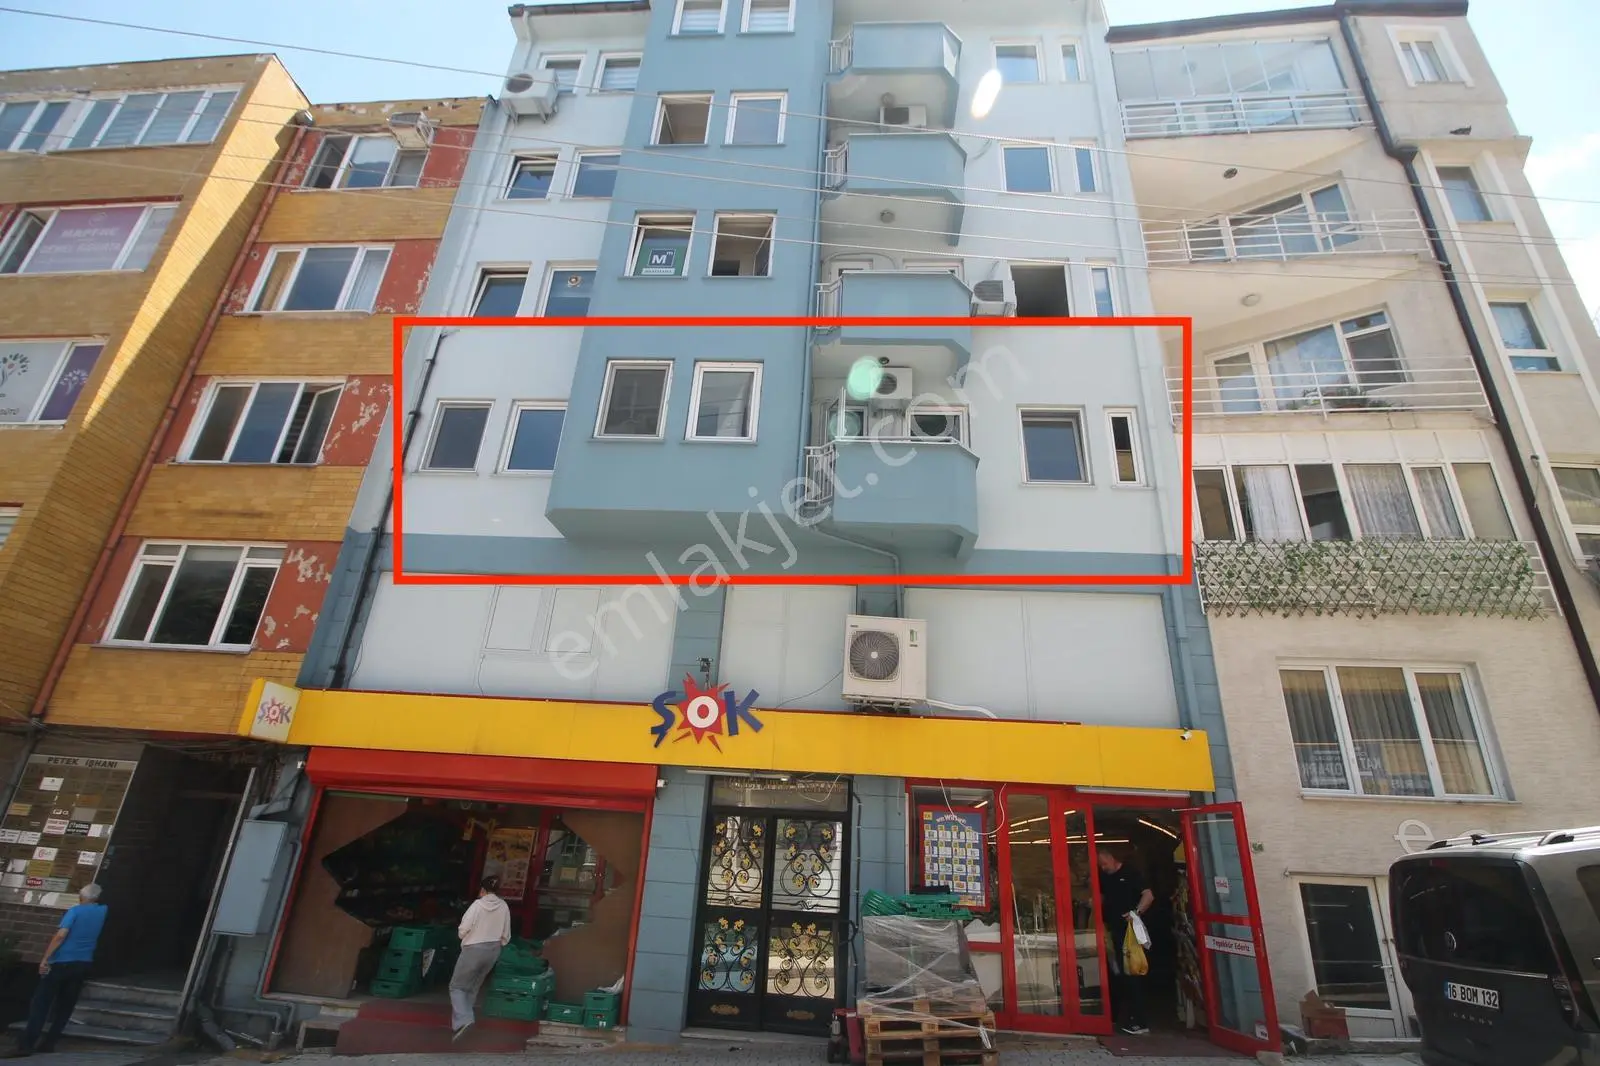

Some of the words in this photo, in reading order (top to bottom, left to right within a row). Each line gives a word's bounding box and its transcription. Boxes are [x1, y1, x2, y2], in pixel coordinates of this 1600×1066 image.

[650, 688, 764, 749] ŞOK
[48, 757, 79, 766] PETEK
[1448, 983, 1457, 999] 16
[1460, 986, 1478, 1004] BOM
[1482, 990, 1498, 1008] 132
